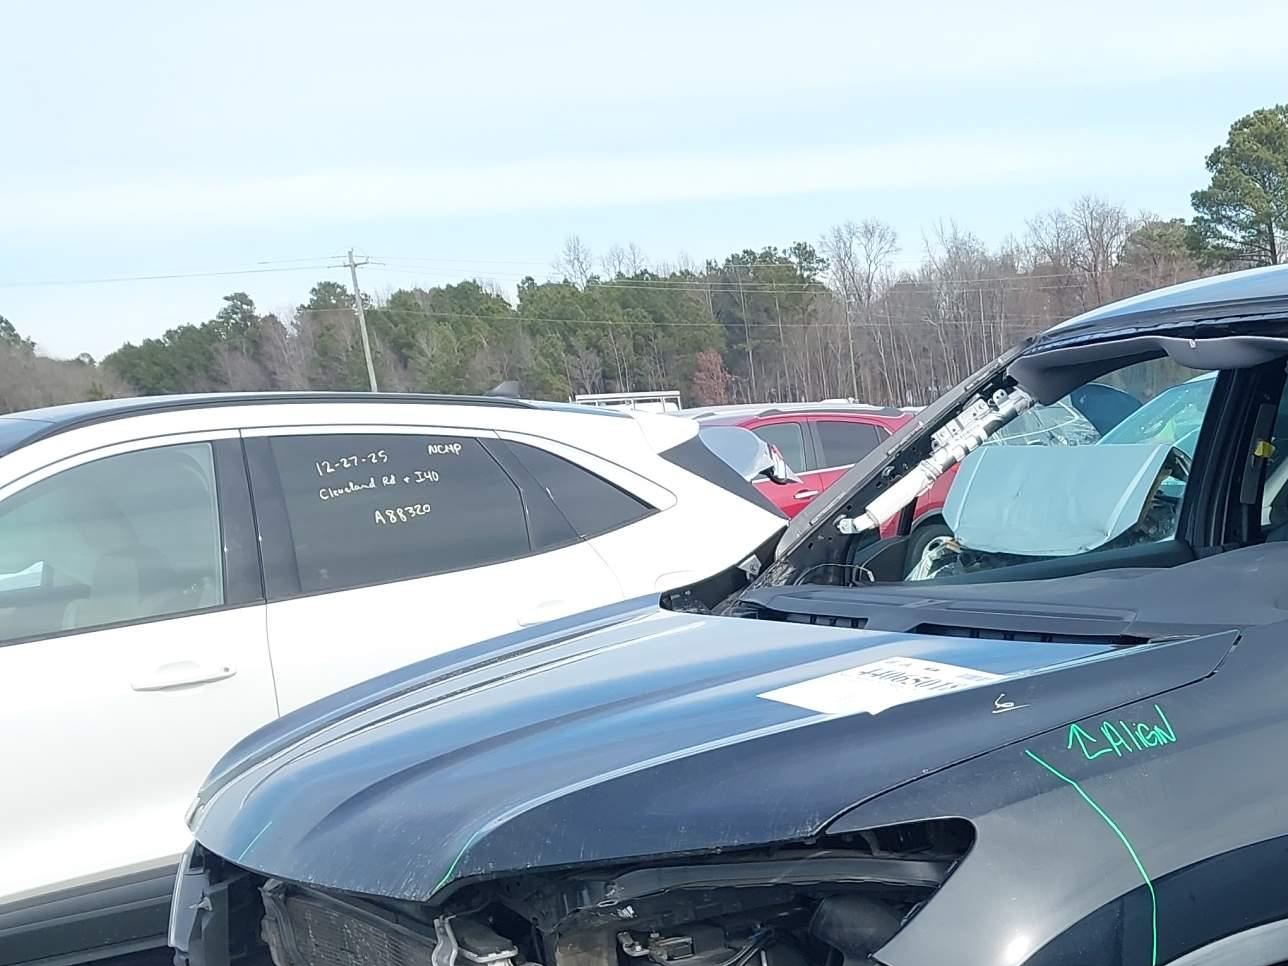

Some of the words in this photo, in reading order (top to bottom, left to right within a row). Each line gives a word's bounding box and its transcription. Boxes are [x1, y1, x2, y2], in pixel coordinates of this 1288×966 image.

[316, 450, 388, 477] 12-27-25
[319, 477, 376, 500] Cleveland
[382, 474, 397, 486] Rd
[374, 503, 431, 525] A88320
